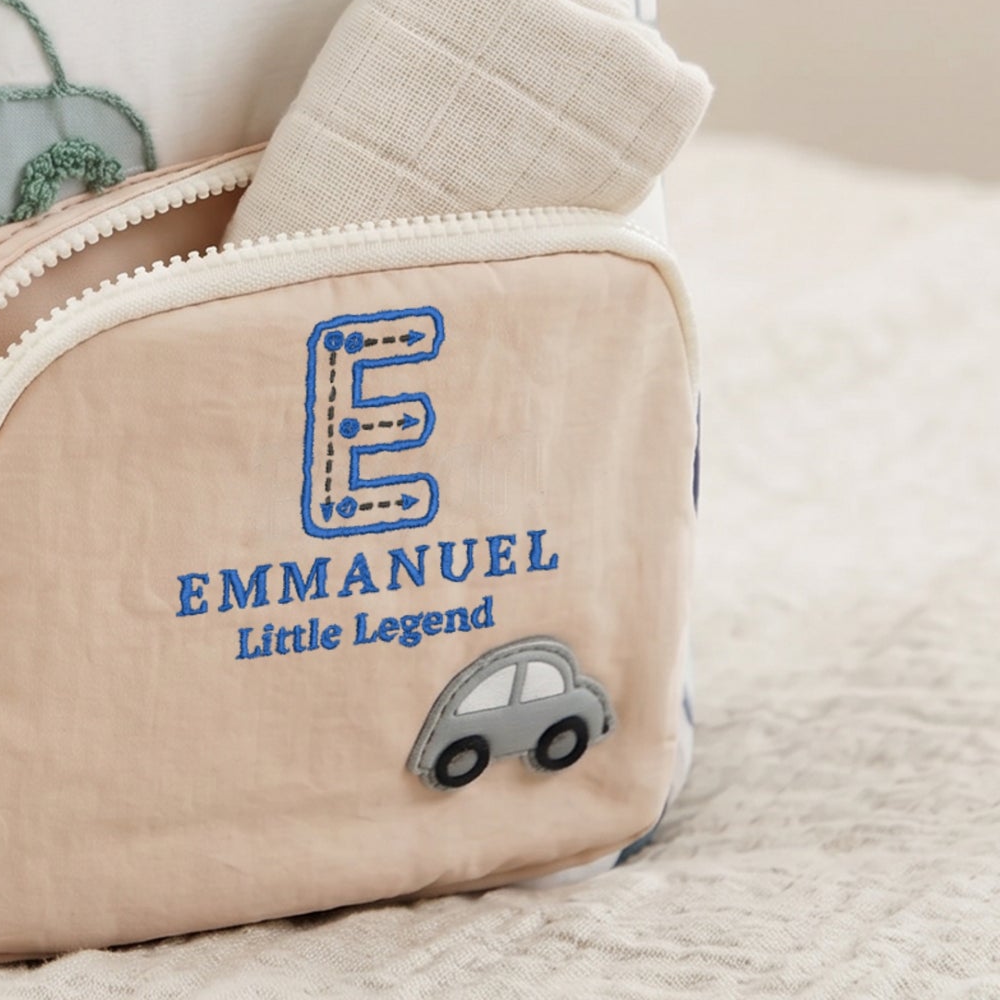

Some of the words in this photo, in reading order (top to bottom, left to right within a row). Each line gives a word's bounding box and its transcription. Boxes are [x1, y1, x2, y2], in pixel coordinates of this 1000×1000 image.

[301, 306, 445, 539] E
[176, 529, 559, 617] EMMANUEL
[236, 617, 343, 660] Little
[354, 595, 495, 648] Legend
